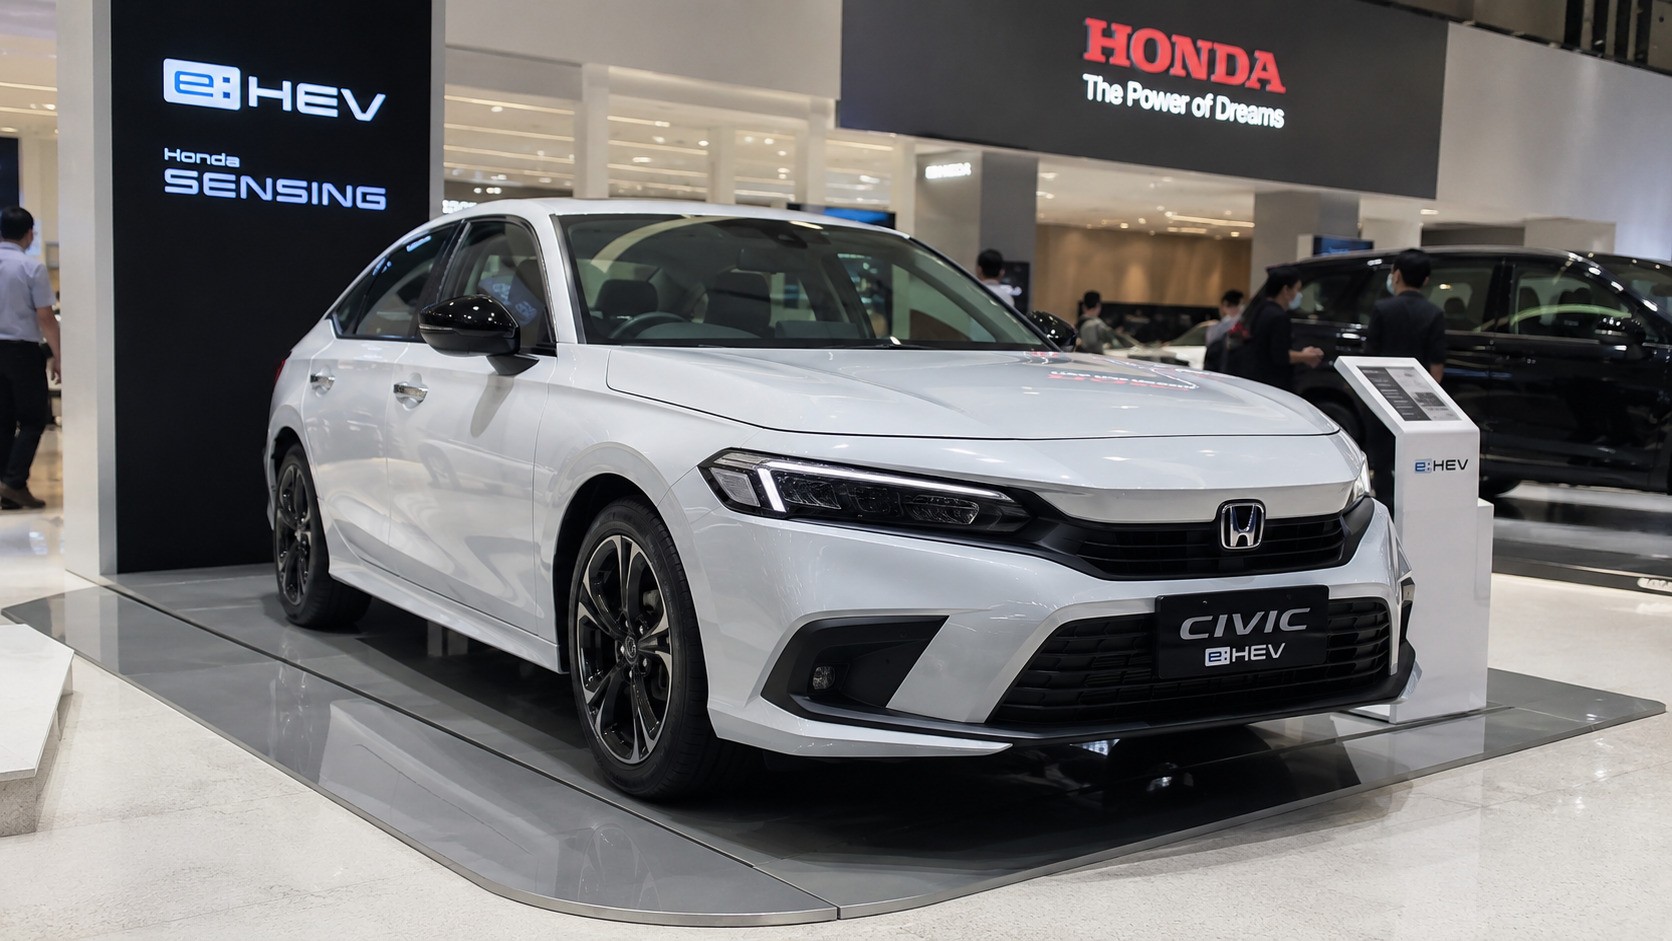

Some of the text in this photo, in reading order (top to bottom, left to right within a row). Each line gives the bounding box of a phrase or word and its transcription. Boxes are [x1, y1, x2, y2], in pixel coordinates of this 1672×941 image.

[1083, 17, 1287, 94] HONDA
[163, 58, 386, 122] e:HEV
[1082, 73, 1285, 129] The Power of Dreams
[164, 147, 240, 168] Honda
[164, 168, 387, 211] SENSING
[1414, 459, 1469, 473] e:HEV
[1180, 607, 1311, 640] CIVIC
[1205, 642, 1286, 667] e:HEV
